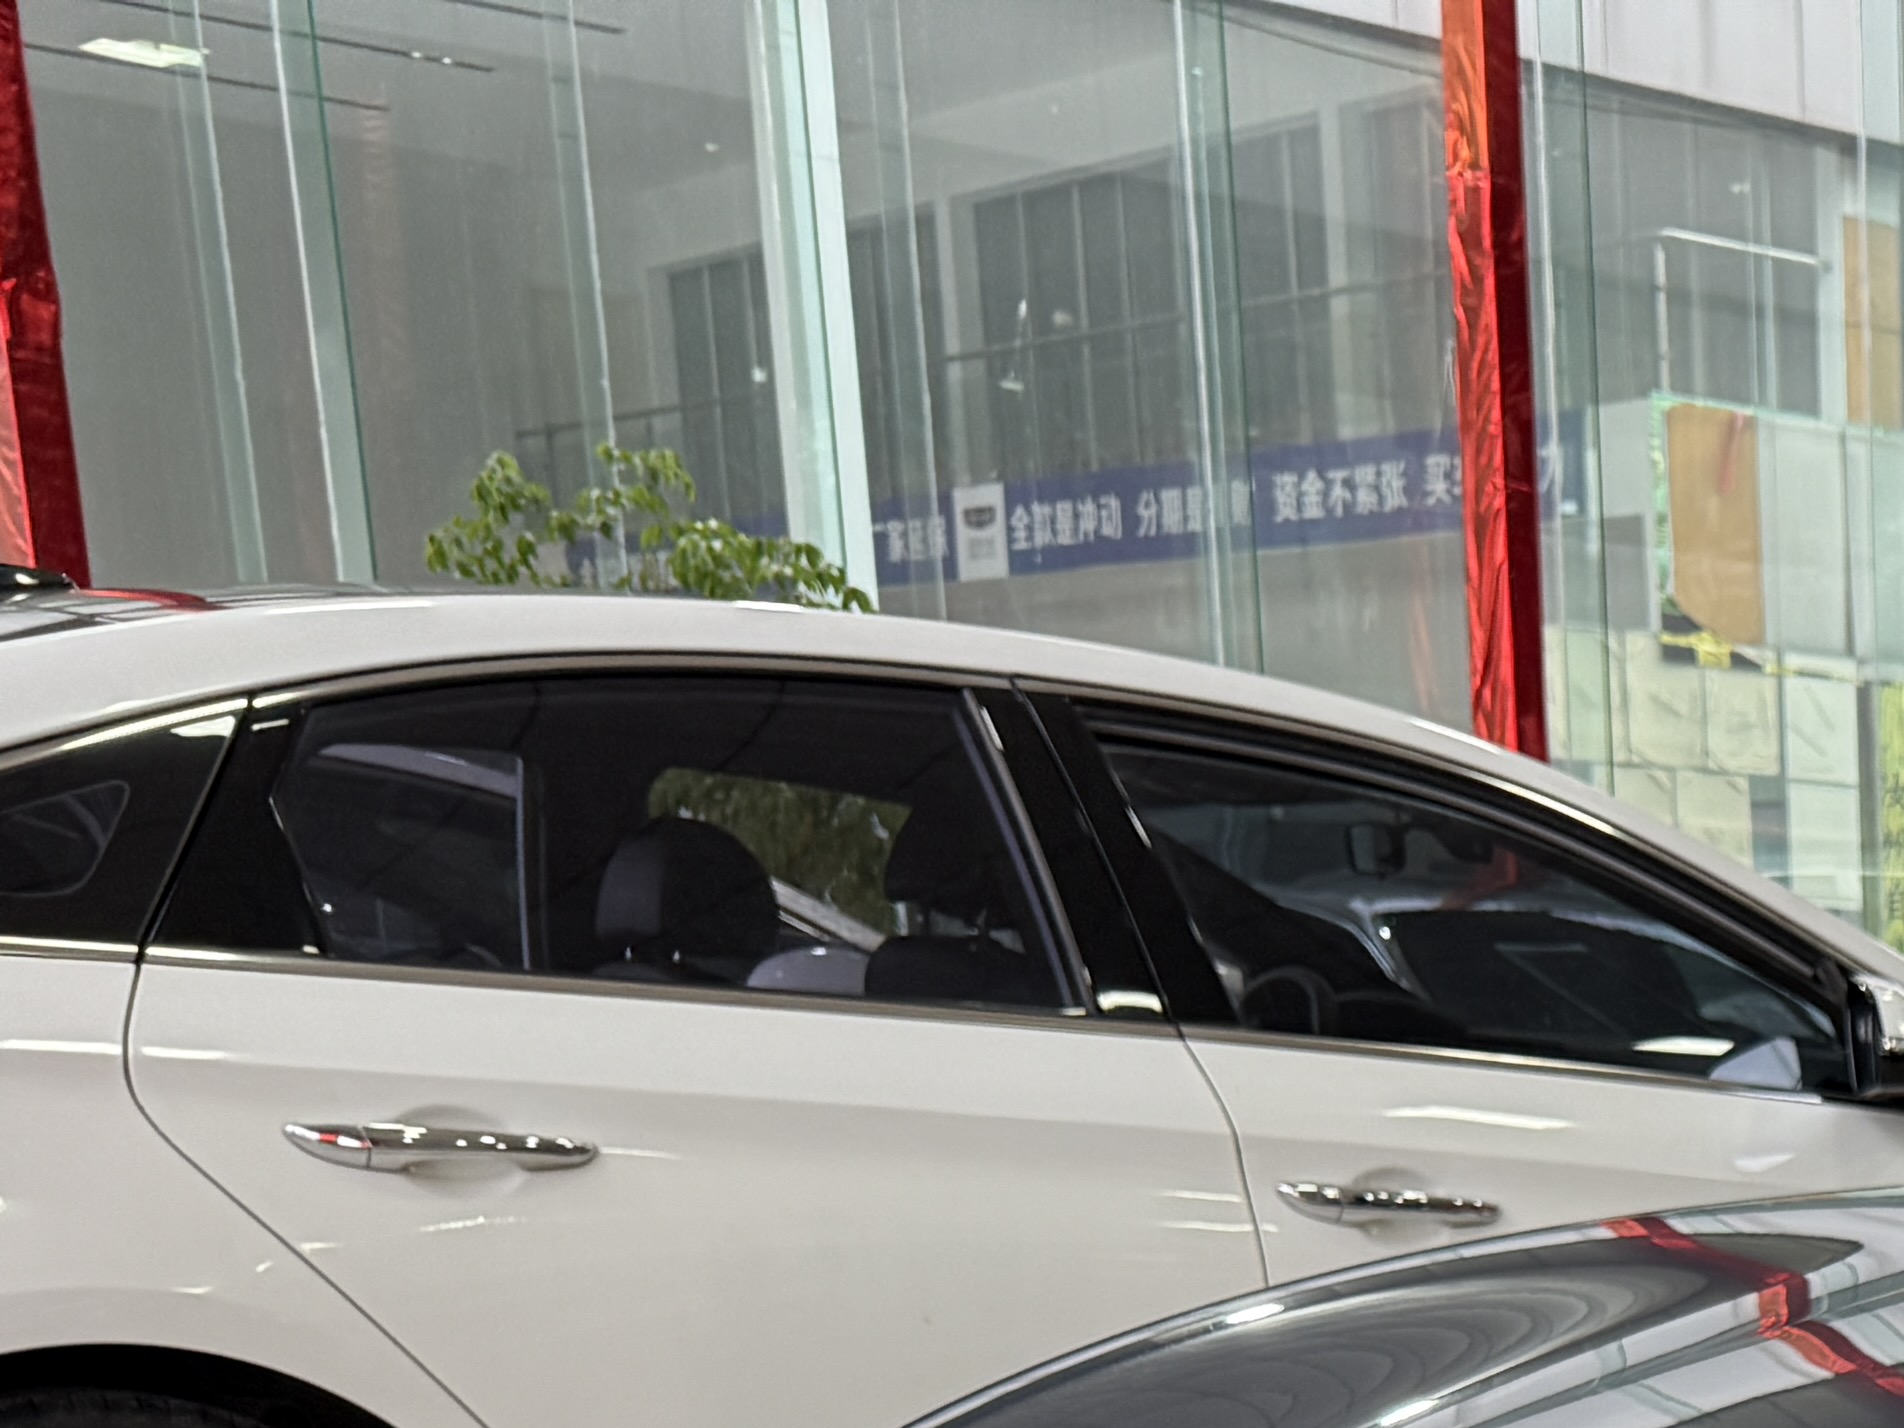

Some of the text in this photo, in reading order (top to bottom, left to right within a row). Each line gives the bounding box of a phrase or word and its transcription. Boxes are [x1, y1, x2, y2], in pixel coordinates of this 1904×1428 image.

[1009, 492, 1123, 552] 全款是冲动
[1271, 459, 1409, 524] 资金不紧张
